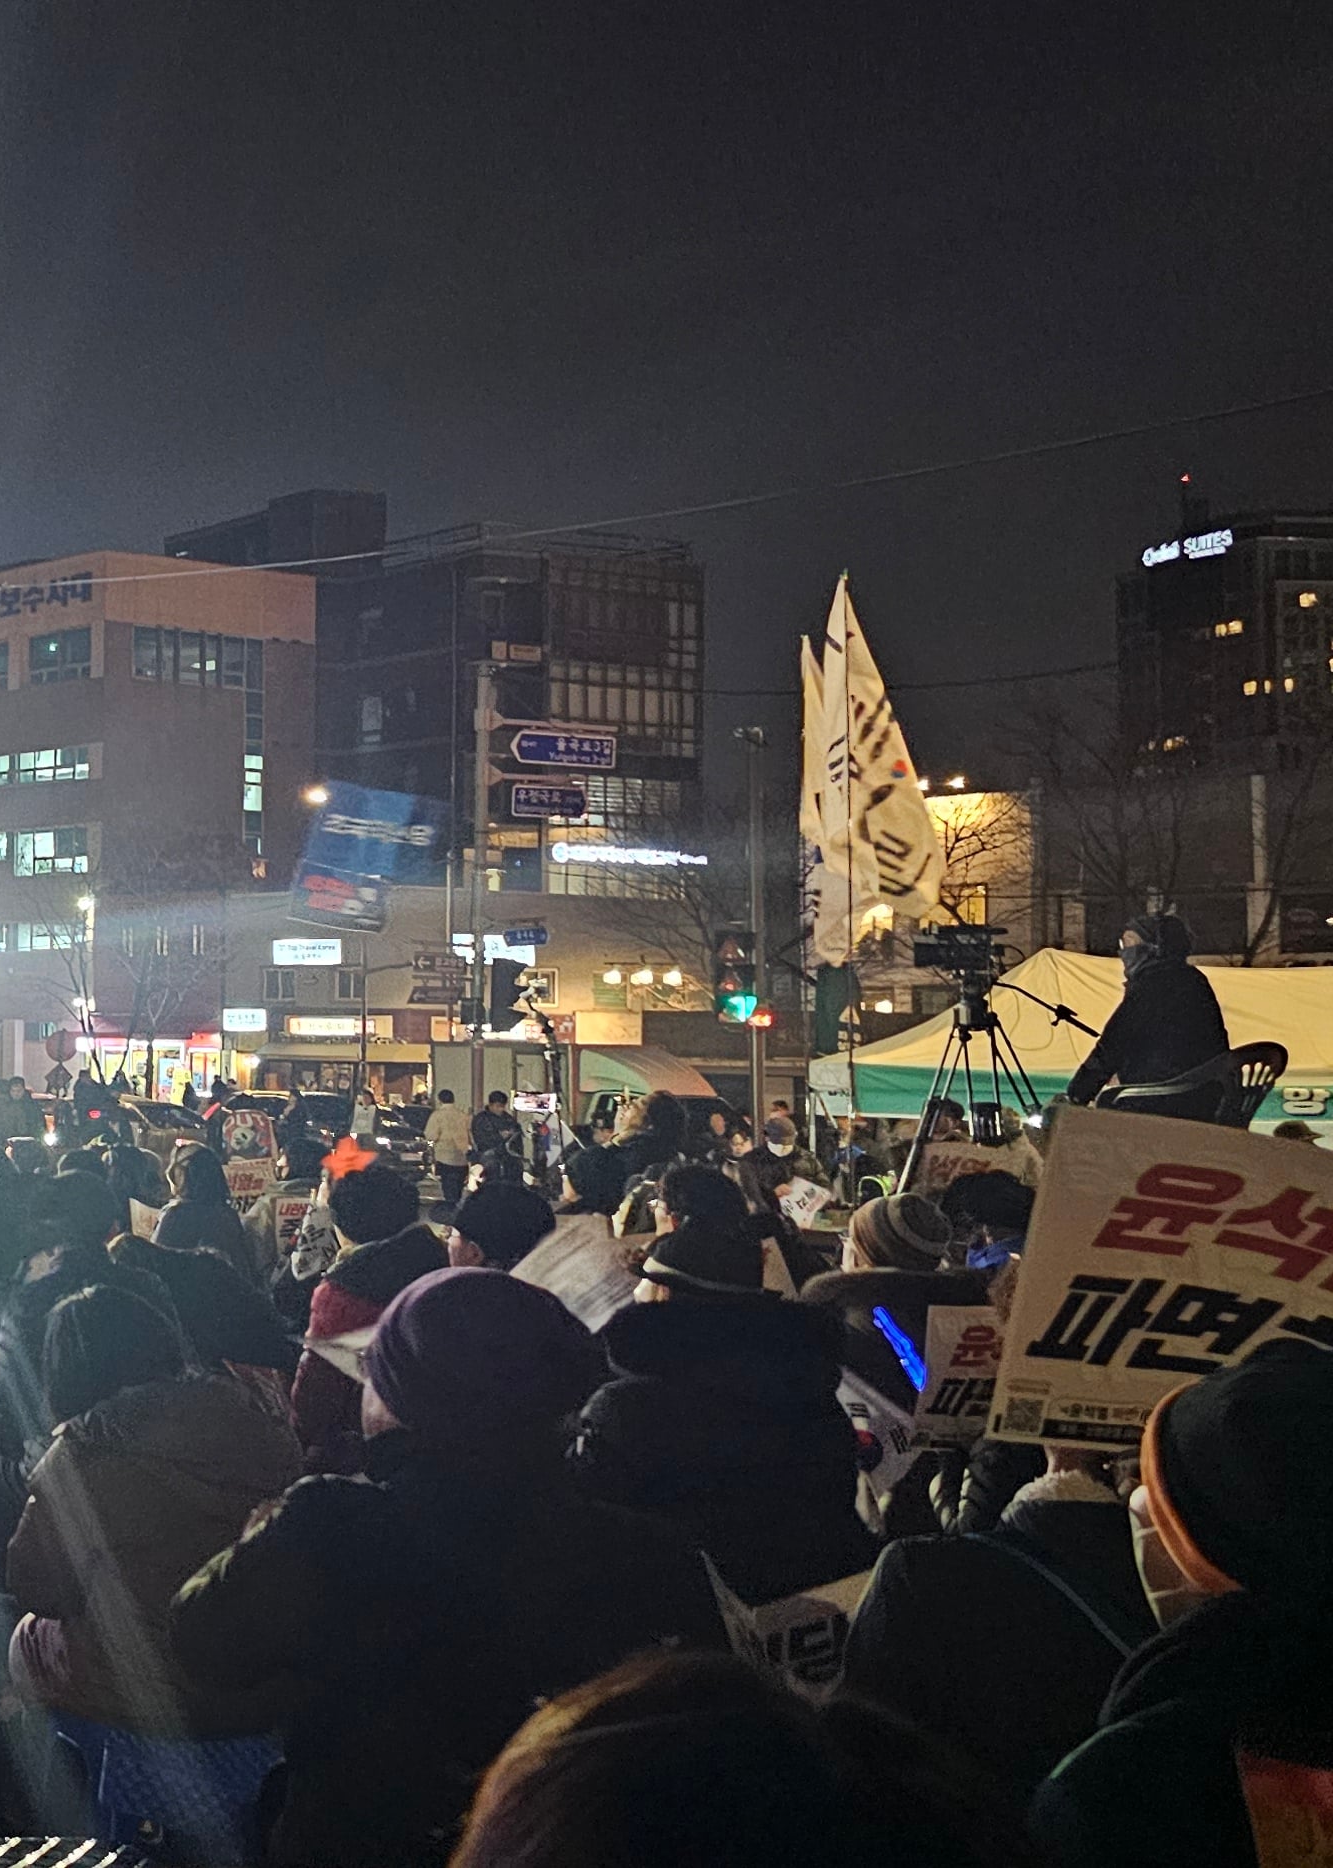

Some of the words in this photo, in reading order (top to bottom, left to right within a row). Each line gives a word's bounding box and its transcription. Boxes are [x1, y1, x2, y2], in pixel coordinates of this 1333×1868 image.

[1183, 529, 1233, 555] SUITES
[1092, 1163, 1333, 1293] 윤석
[1026, 1274, 1333, 1376] 파면
